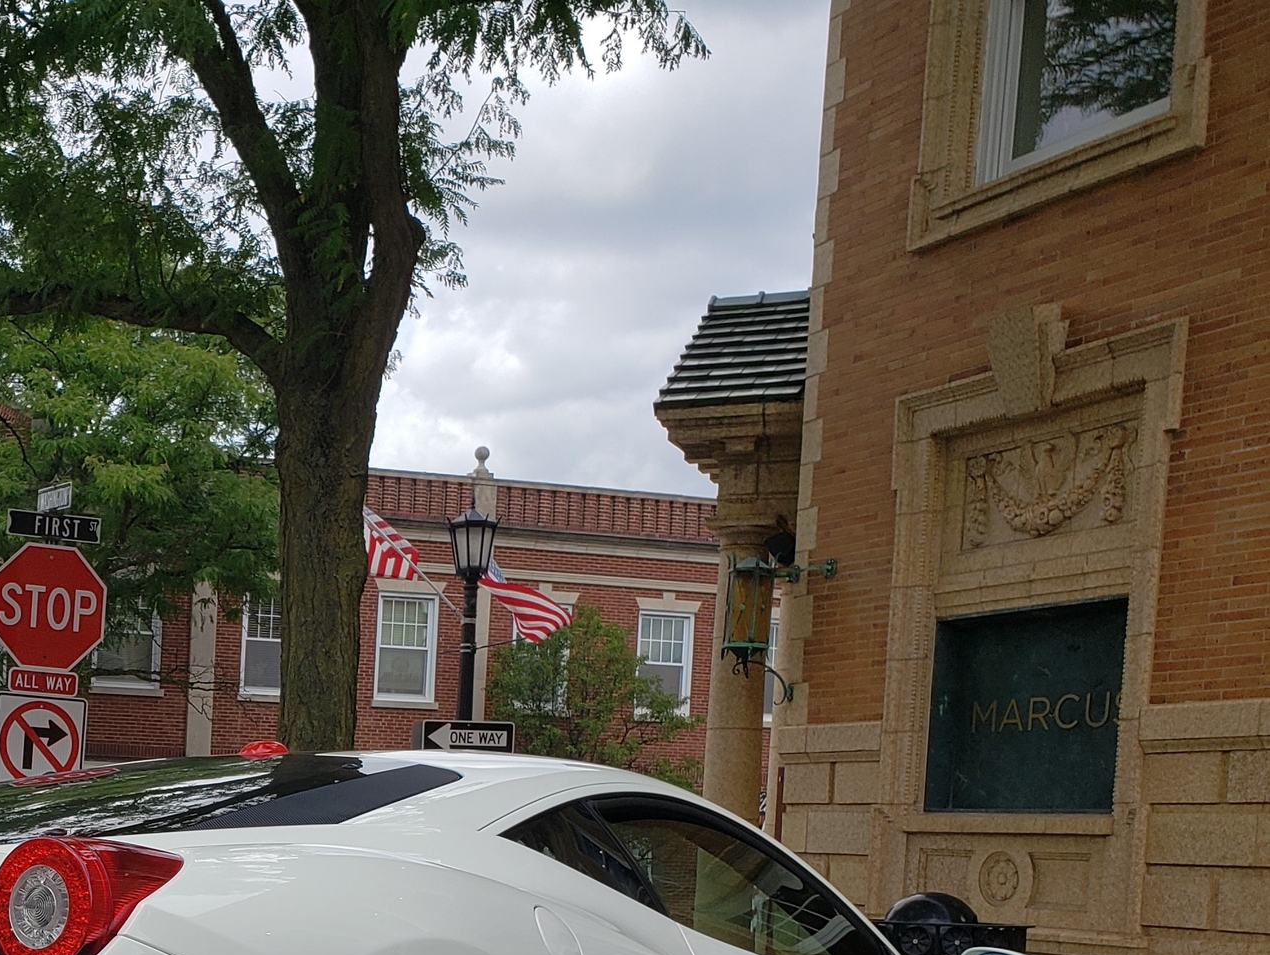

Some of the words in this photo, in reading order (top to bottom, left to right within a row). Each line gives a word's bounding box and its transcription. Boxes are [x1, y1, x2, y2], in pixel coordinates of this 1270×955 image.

[34, 515, 81, 538] FIRST
[89, 521, 98, 532] ST
[15, 672, 39, 690] ALL
[45, 674, 73, 692] WAY
[449, 731, 474, 744] ONE
[479, 732, 504, 745] WAY
